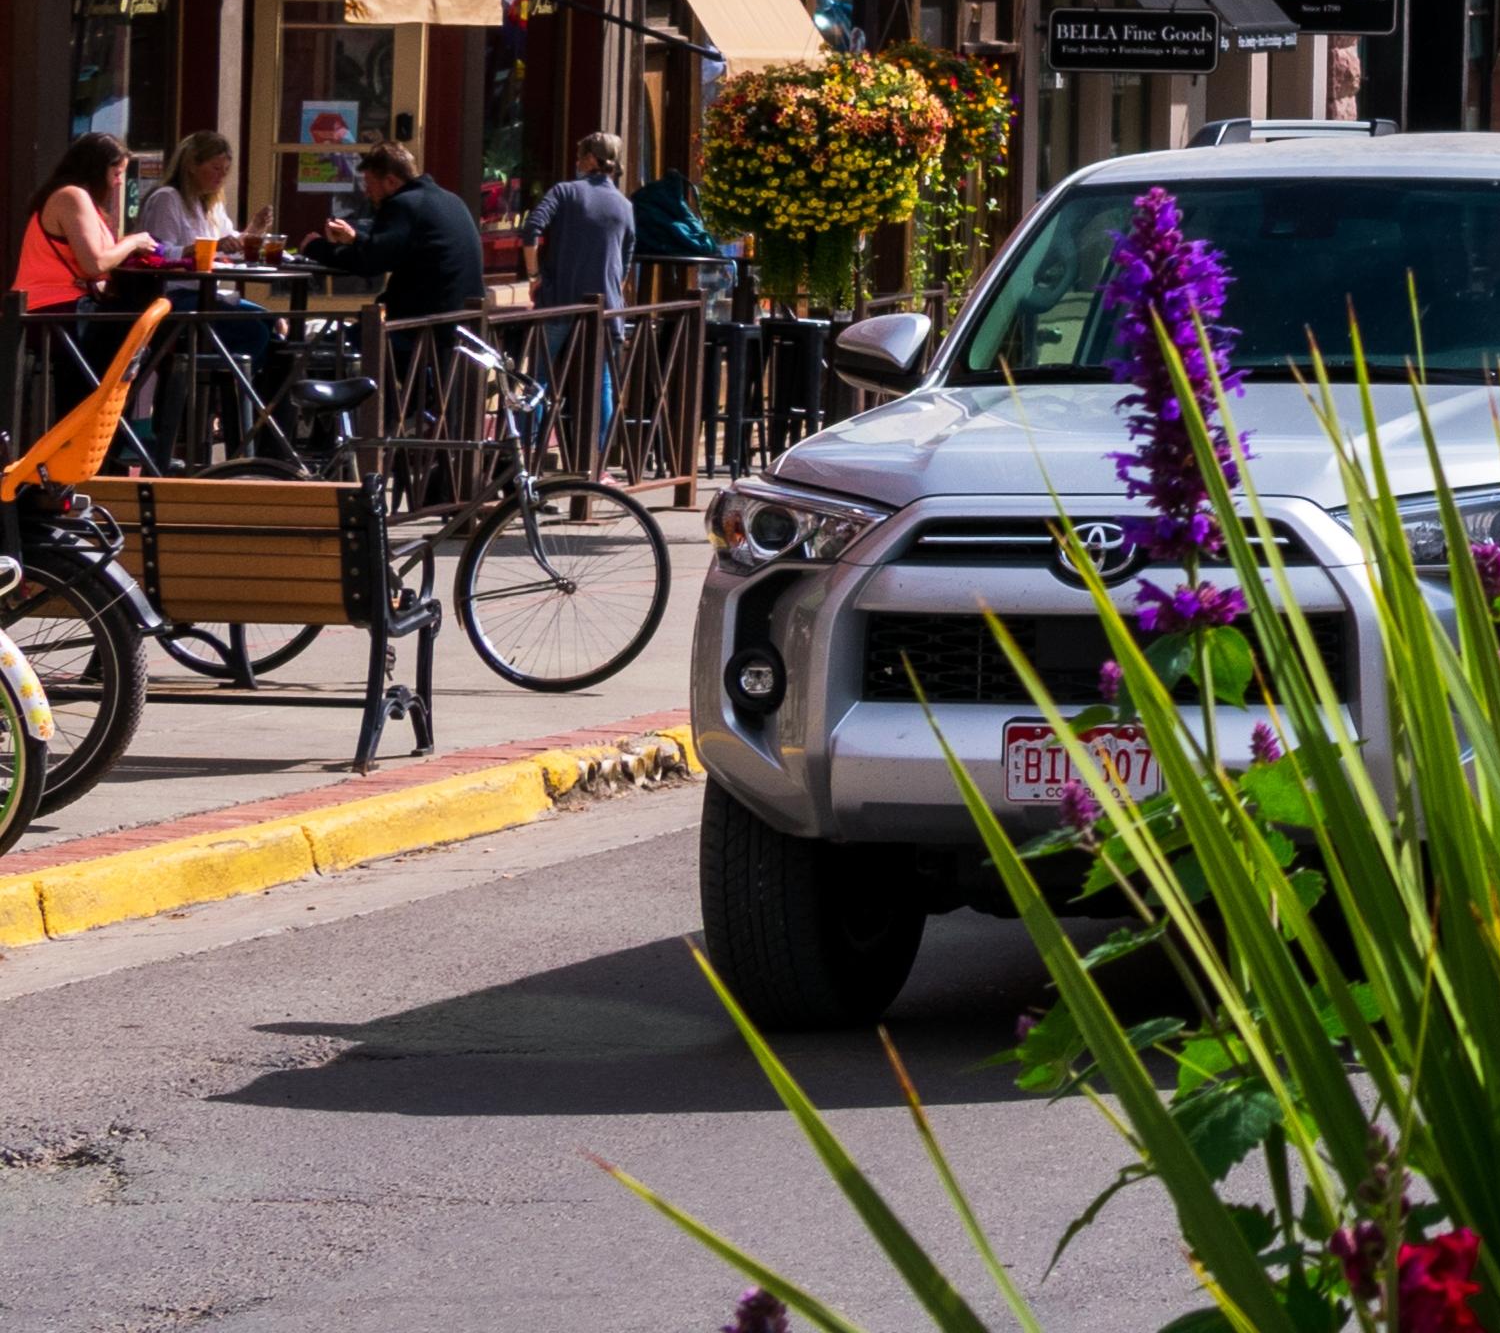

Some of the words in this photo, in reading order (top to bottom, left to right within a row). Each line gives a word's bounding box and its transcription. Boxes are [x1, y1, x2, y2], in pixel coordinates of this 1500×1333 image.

[1056, 24, 1118, 40] BELLA
[1123, 24, 1157, 41] Fine
[1161, 25, 1213, 42] Goods
